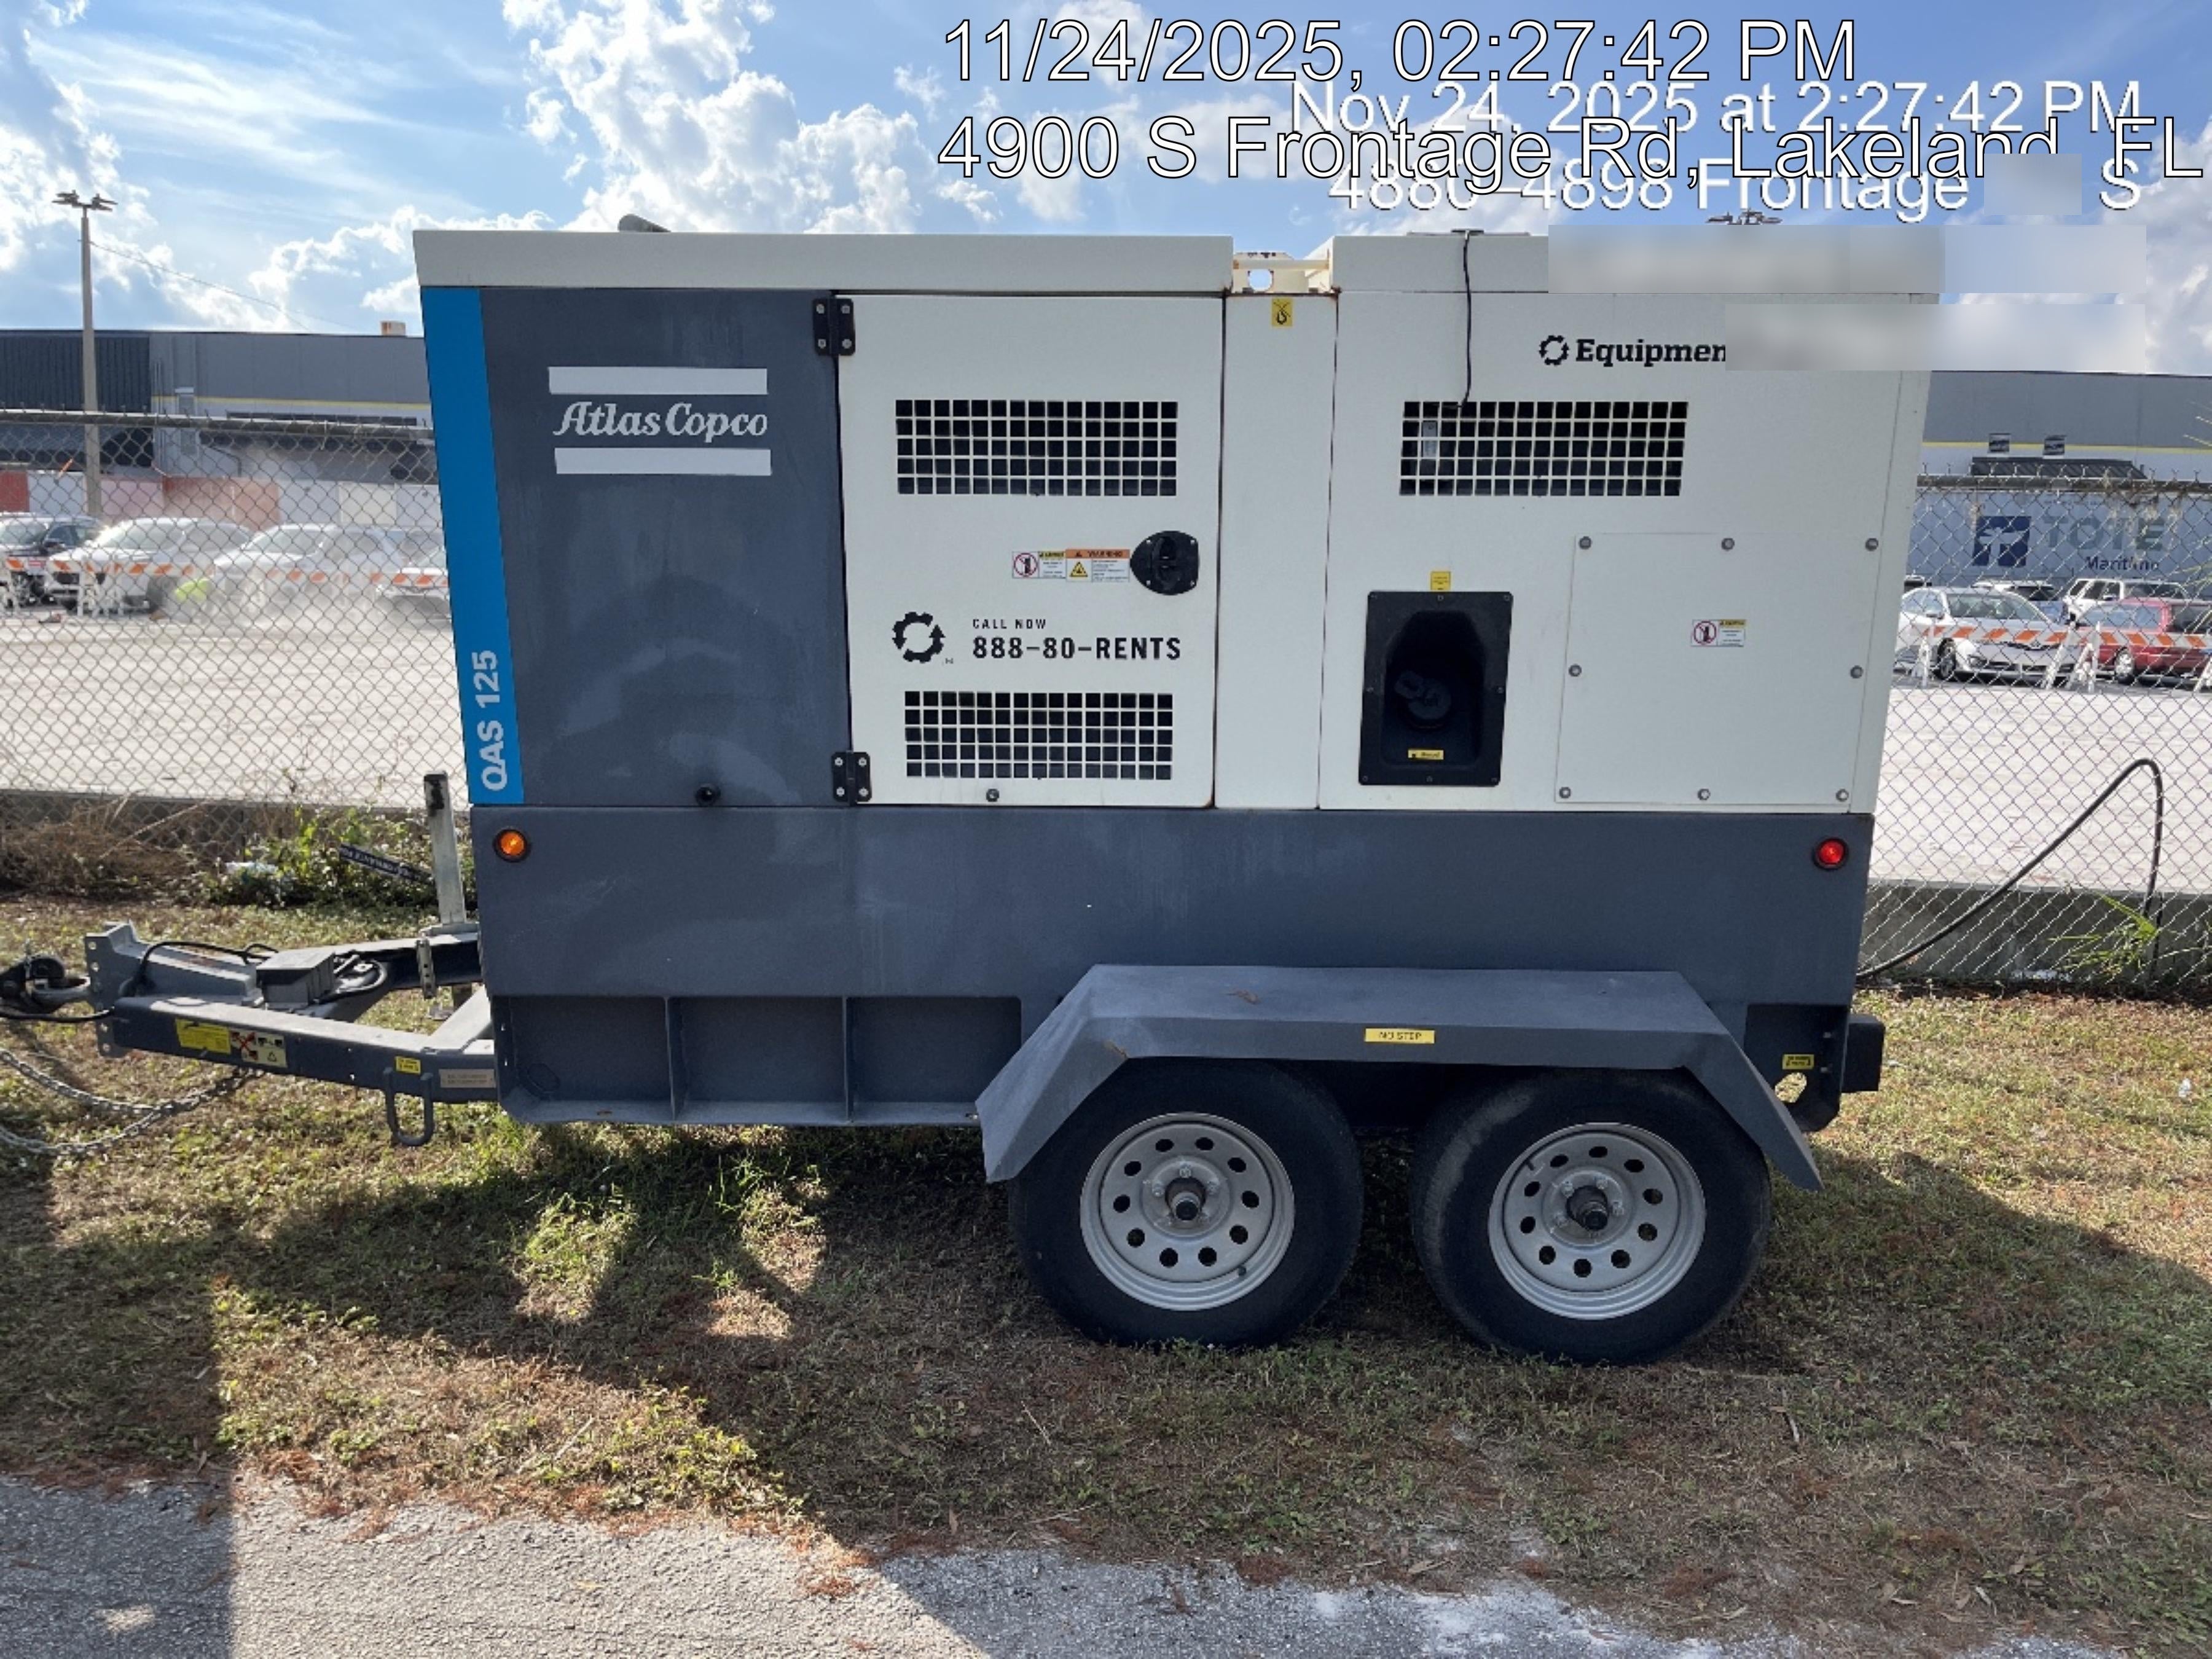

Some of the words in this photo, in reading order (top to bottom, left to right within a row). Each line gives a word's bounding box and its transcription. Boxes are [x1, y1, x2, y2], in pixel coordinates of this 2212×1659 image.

[1575, 339, 1725, 367] Equipmen
[553, 401, 661, 436] Atlas
[664, 402, 768, 443] Copco
[972, 618, 1007, 629] CALL
[1014, 618, 1046, 629] NOW
[972, 636, 1181, 660] 888-80-RENTS
[471, 650, 501, 708] 125
[477, 720, 508, 791] QAS
